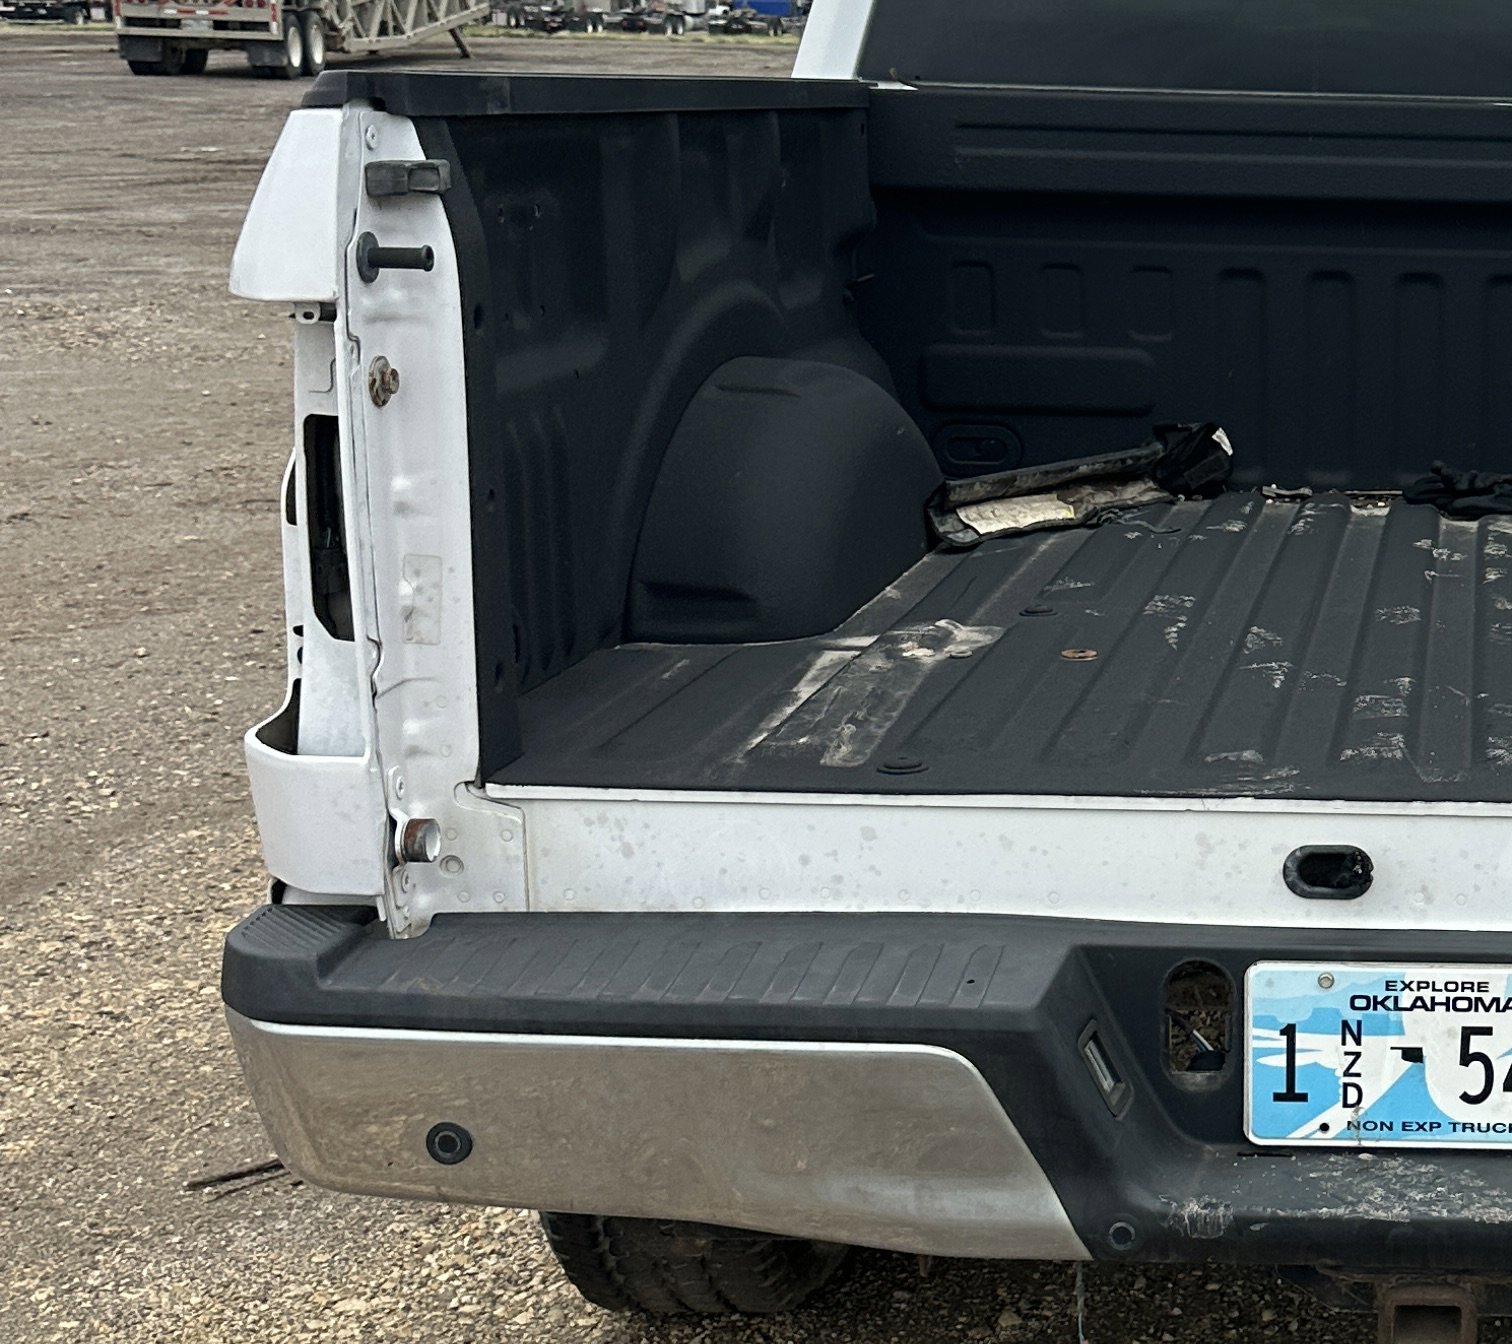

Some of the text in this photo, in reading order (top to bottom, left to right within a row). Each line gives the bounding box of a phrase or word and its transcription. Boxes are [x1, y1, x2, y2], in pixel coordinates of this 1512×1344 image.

[1384, 980, 1490, 993] EXPLORE
[1272, 1023, 1309, 1103] 1
[1346, 1120, 1394, 1132] NON
[1401, 1121, 1442, 1132] EXP
